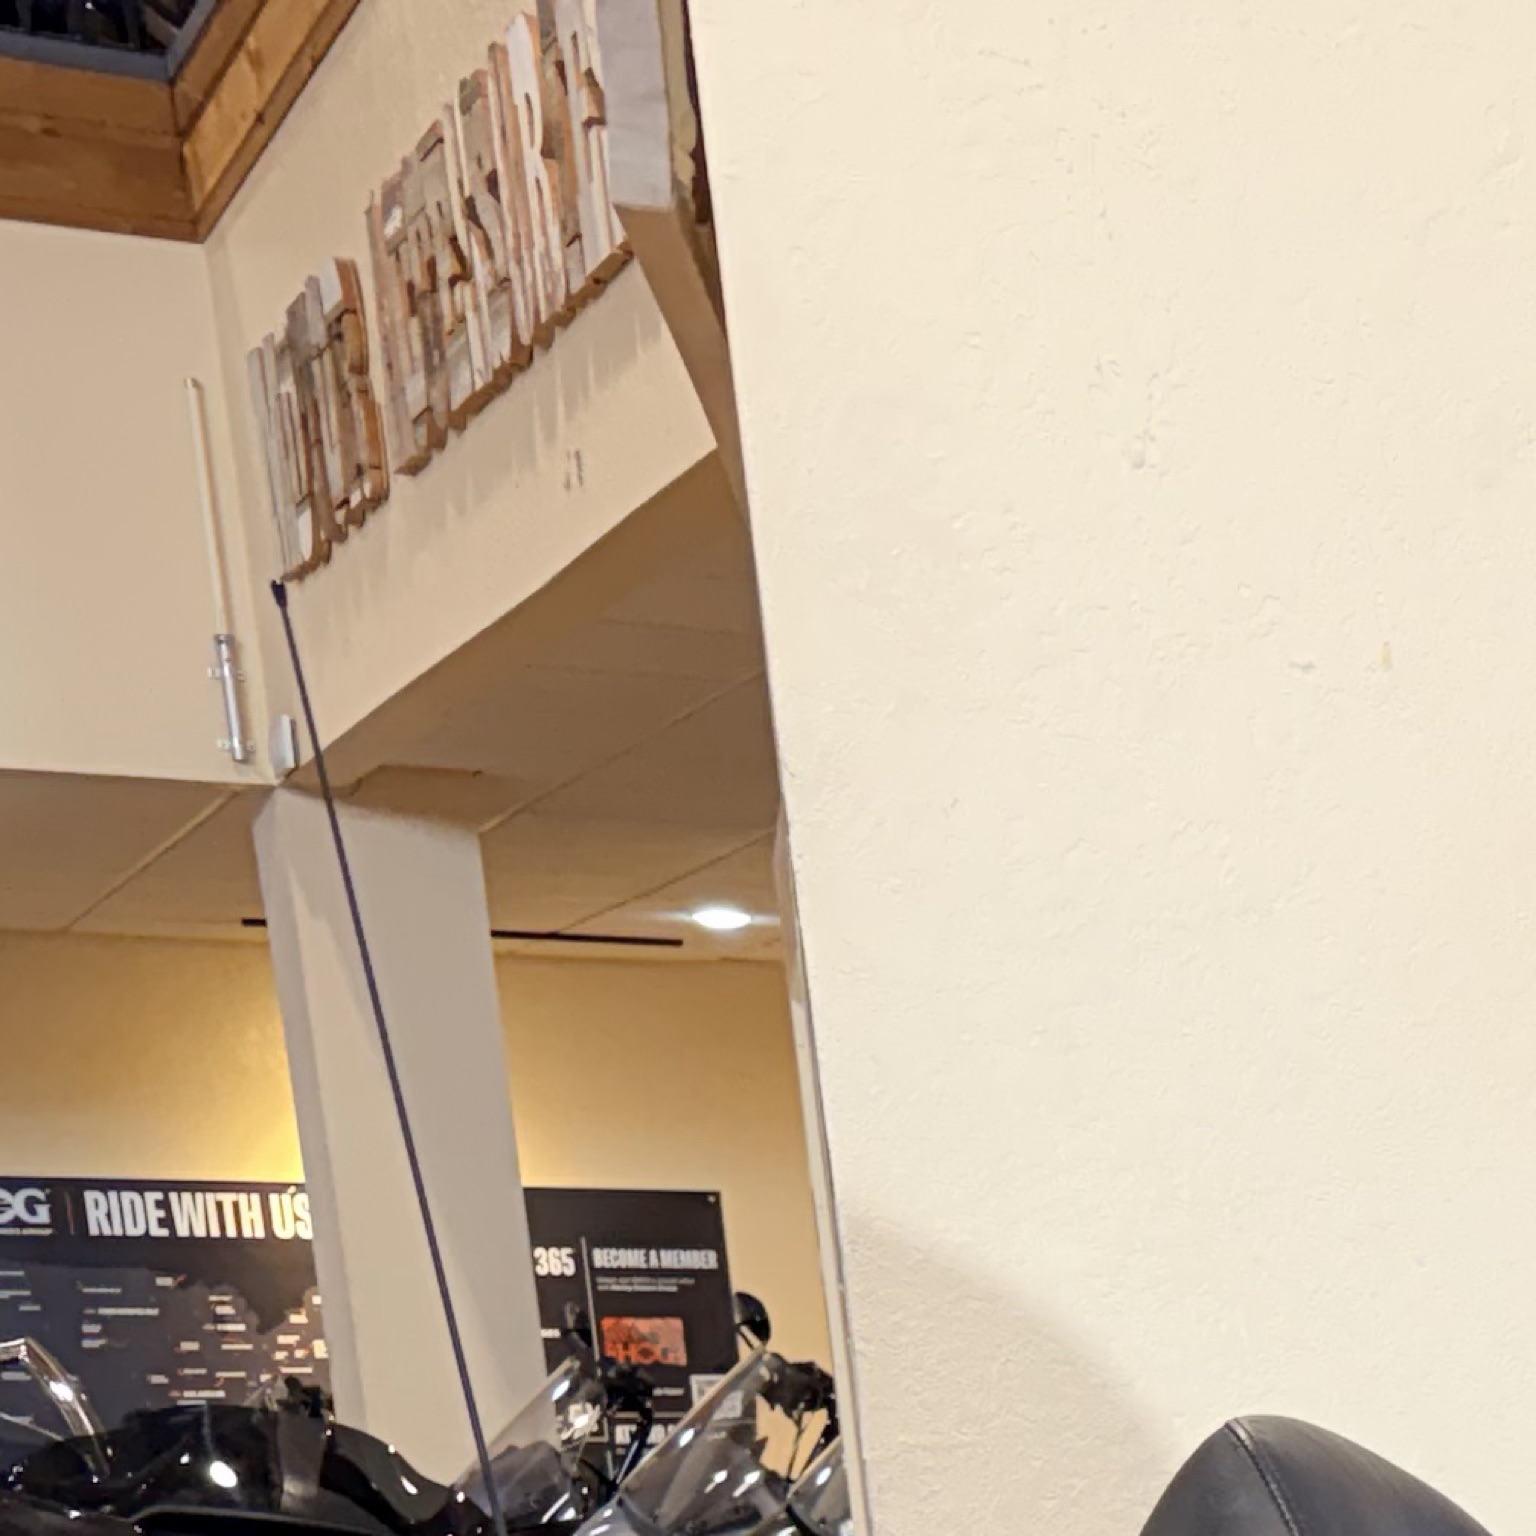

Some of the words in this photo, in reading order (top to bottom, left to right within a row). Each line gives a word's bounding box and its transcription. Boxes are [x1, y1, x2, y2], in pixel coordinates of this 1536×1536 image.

[83, 1190, 169, 1237] RIDE
[168, 1191, 266, 1239] WITH
[533, 1246, 576, 1277] 365
